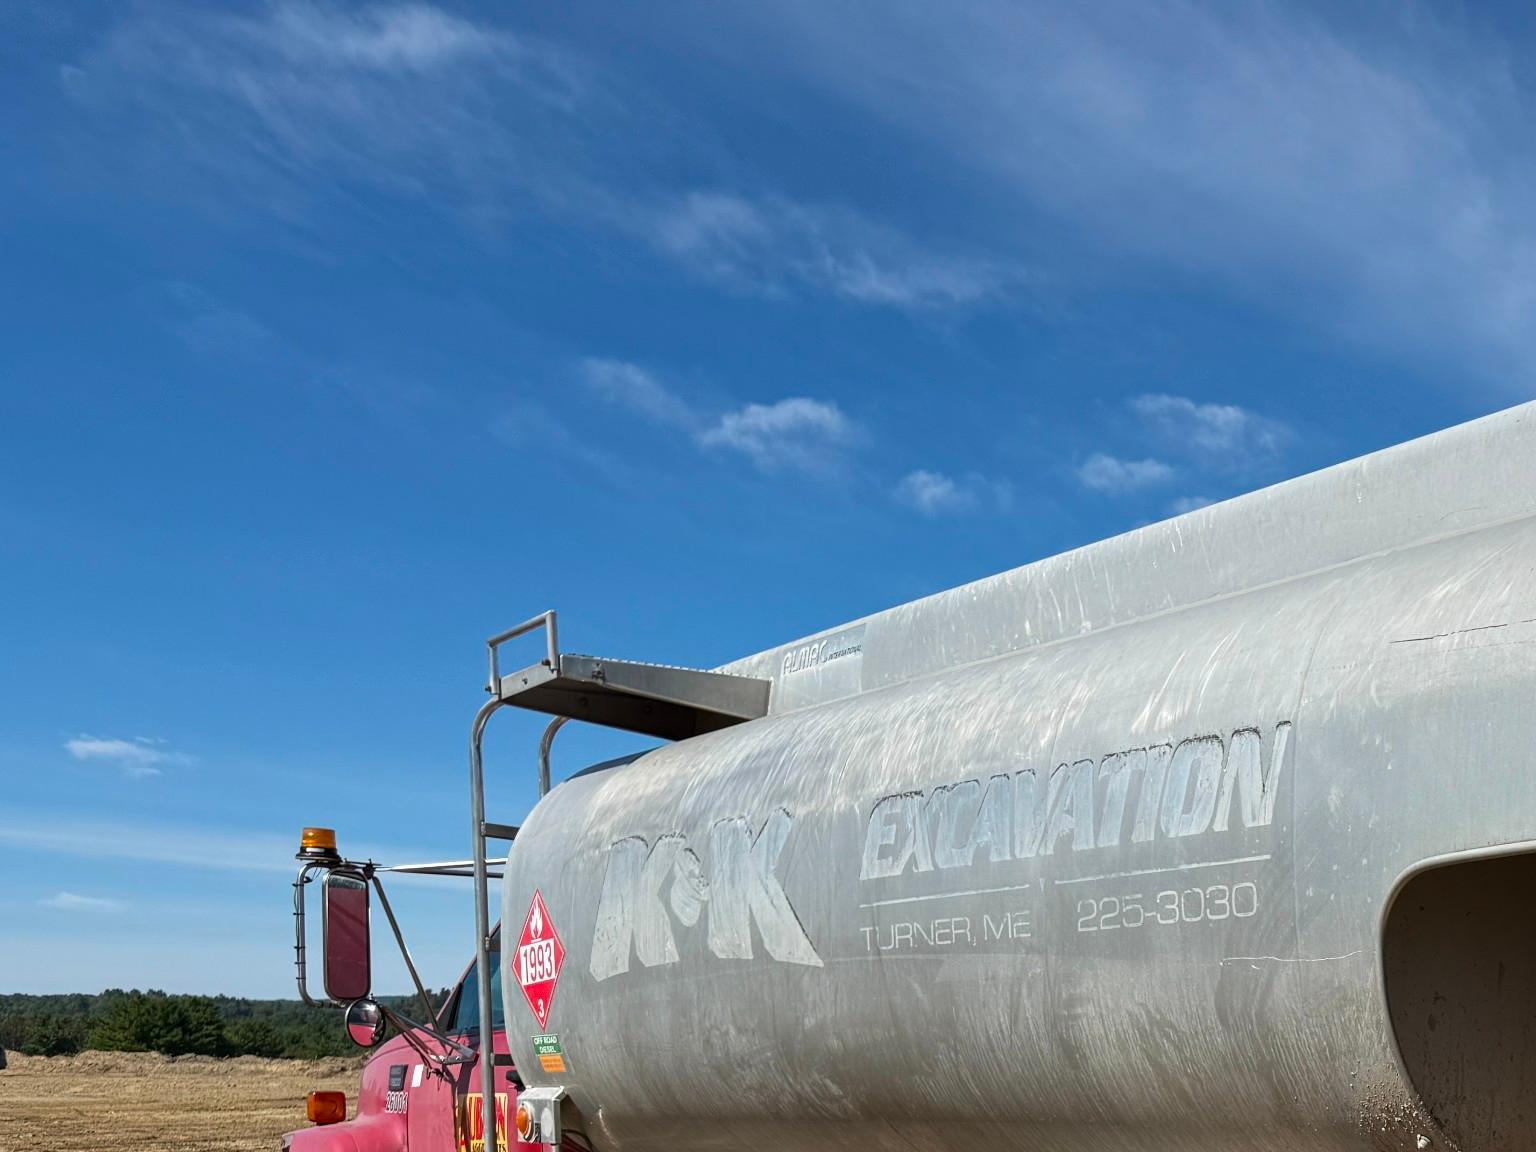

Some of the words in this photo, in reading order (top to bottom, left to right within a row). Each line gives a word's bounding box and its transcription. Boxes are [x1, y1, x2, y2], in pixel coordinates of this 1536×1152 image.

[782, 639, 828, 675] ALMAC
[859, 720, 1293, 881] EXCAVATION
[1077, 881, 1259, 932] 225-3030
[983, 911, 1032, 942] ME
[522, 942, 553, 984] 1993
[538, 998, 545, 1019] 3
[533, 1036, 544, 1046] OFF
